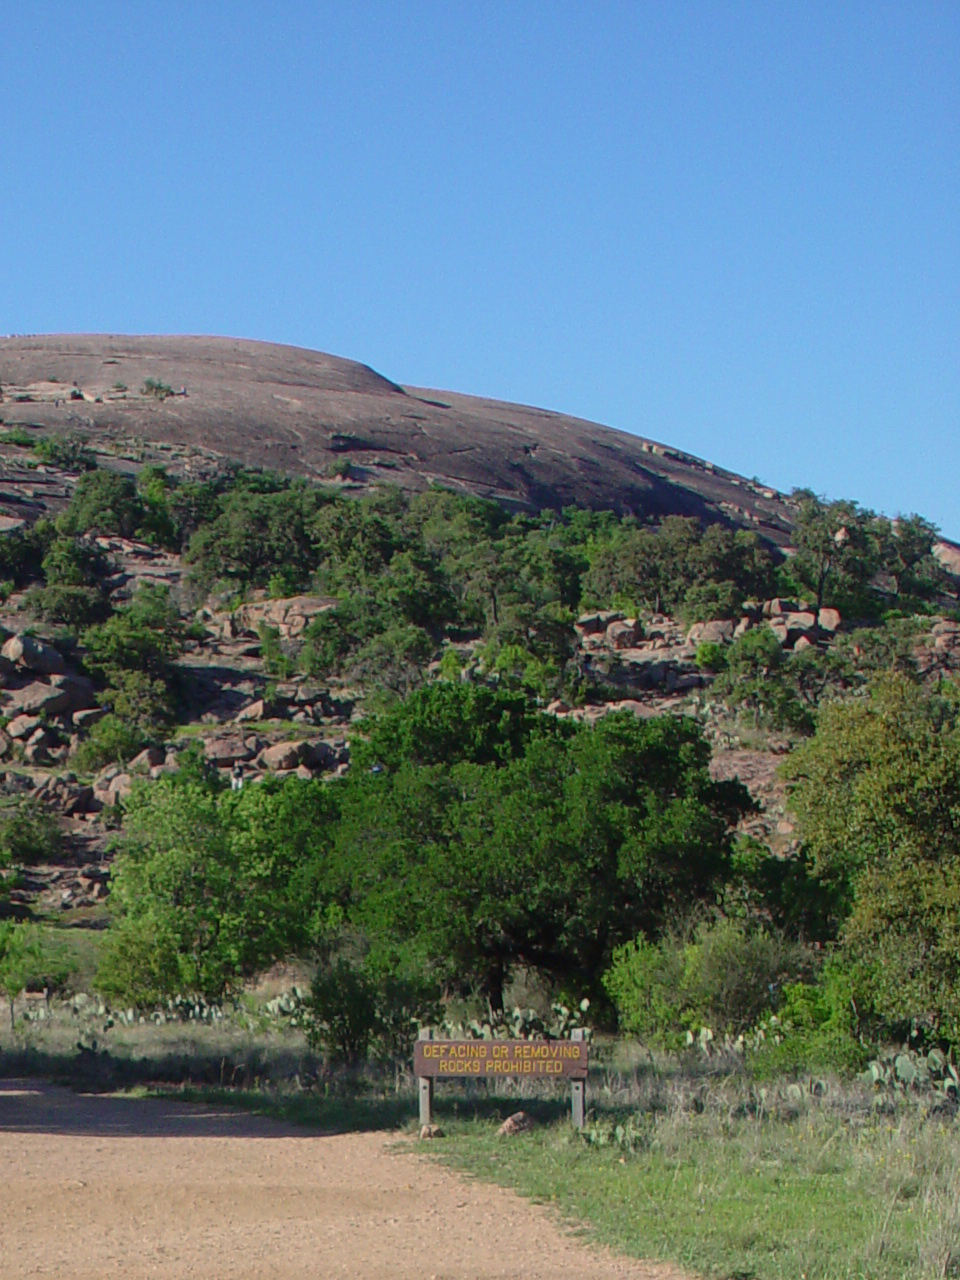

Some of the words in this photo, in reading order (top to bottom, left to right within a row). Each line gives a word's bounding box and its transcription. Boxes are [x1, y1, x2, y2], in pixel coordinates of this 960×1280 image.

[423, 1045, 487, 1058] DEFACING
[492, 1045, 509, 1058] OR
[514, 1045, 580, 1058] REMOVING
[439, 1060, 480, 1073] ROCKS
[485, 1060, 563, 1073] PROHIBITED
